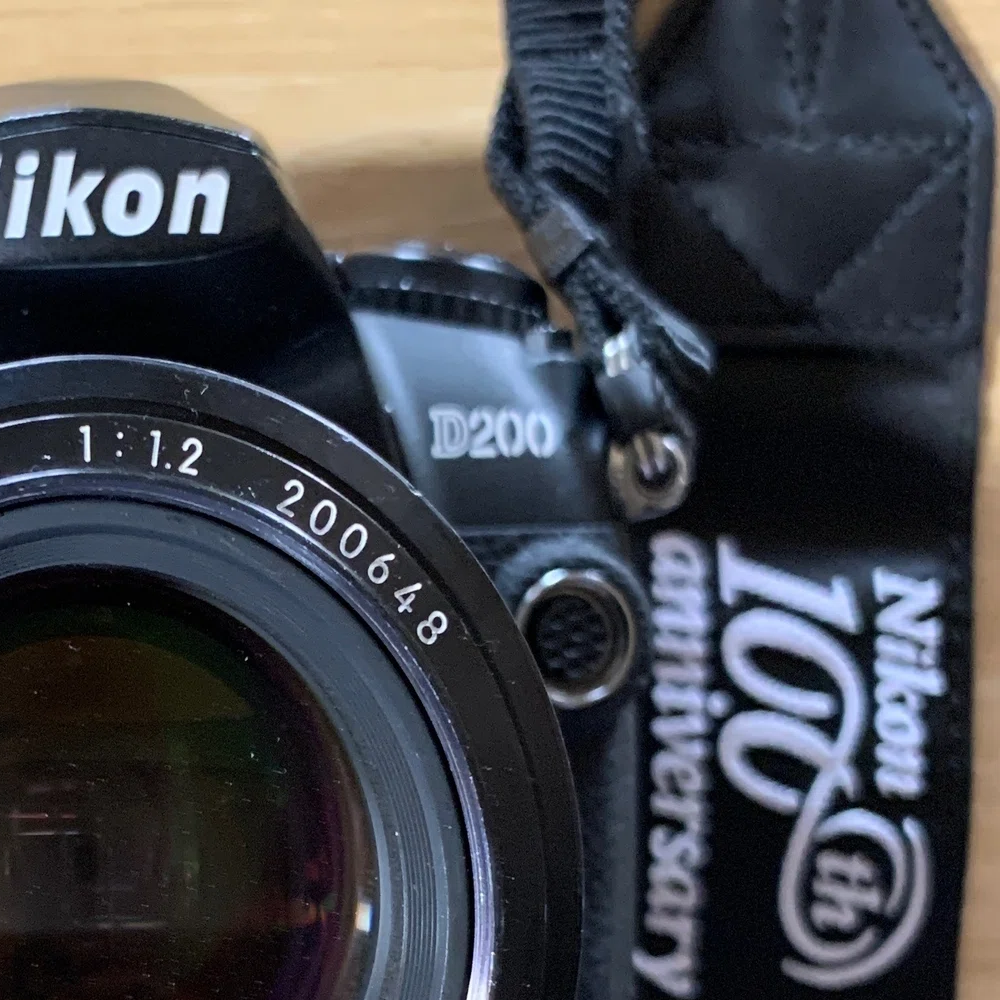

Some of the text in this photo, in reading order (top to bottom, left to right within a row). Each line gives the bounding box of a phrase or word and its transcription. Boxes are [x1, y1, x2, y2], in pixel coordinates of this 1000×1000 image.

[429, 404, 557, 459] D200
[276, 479, 449, 645] 200648
[632, 529, 734, 999] anniversary
[873, 566, 947, 798] Nikon
